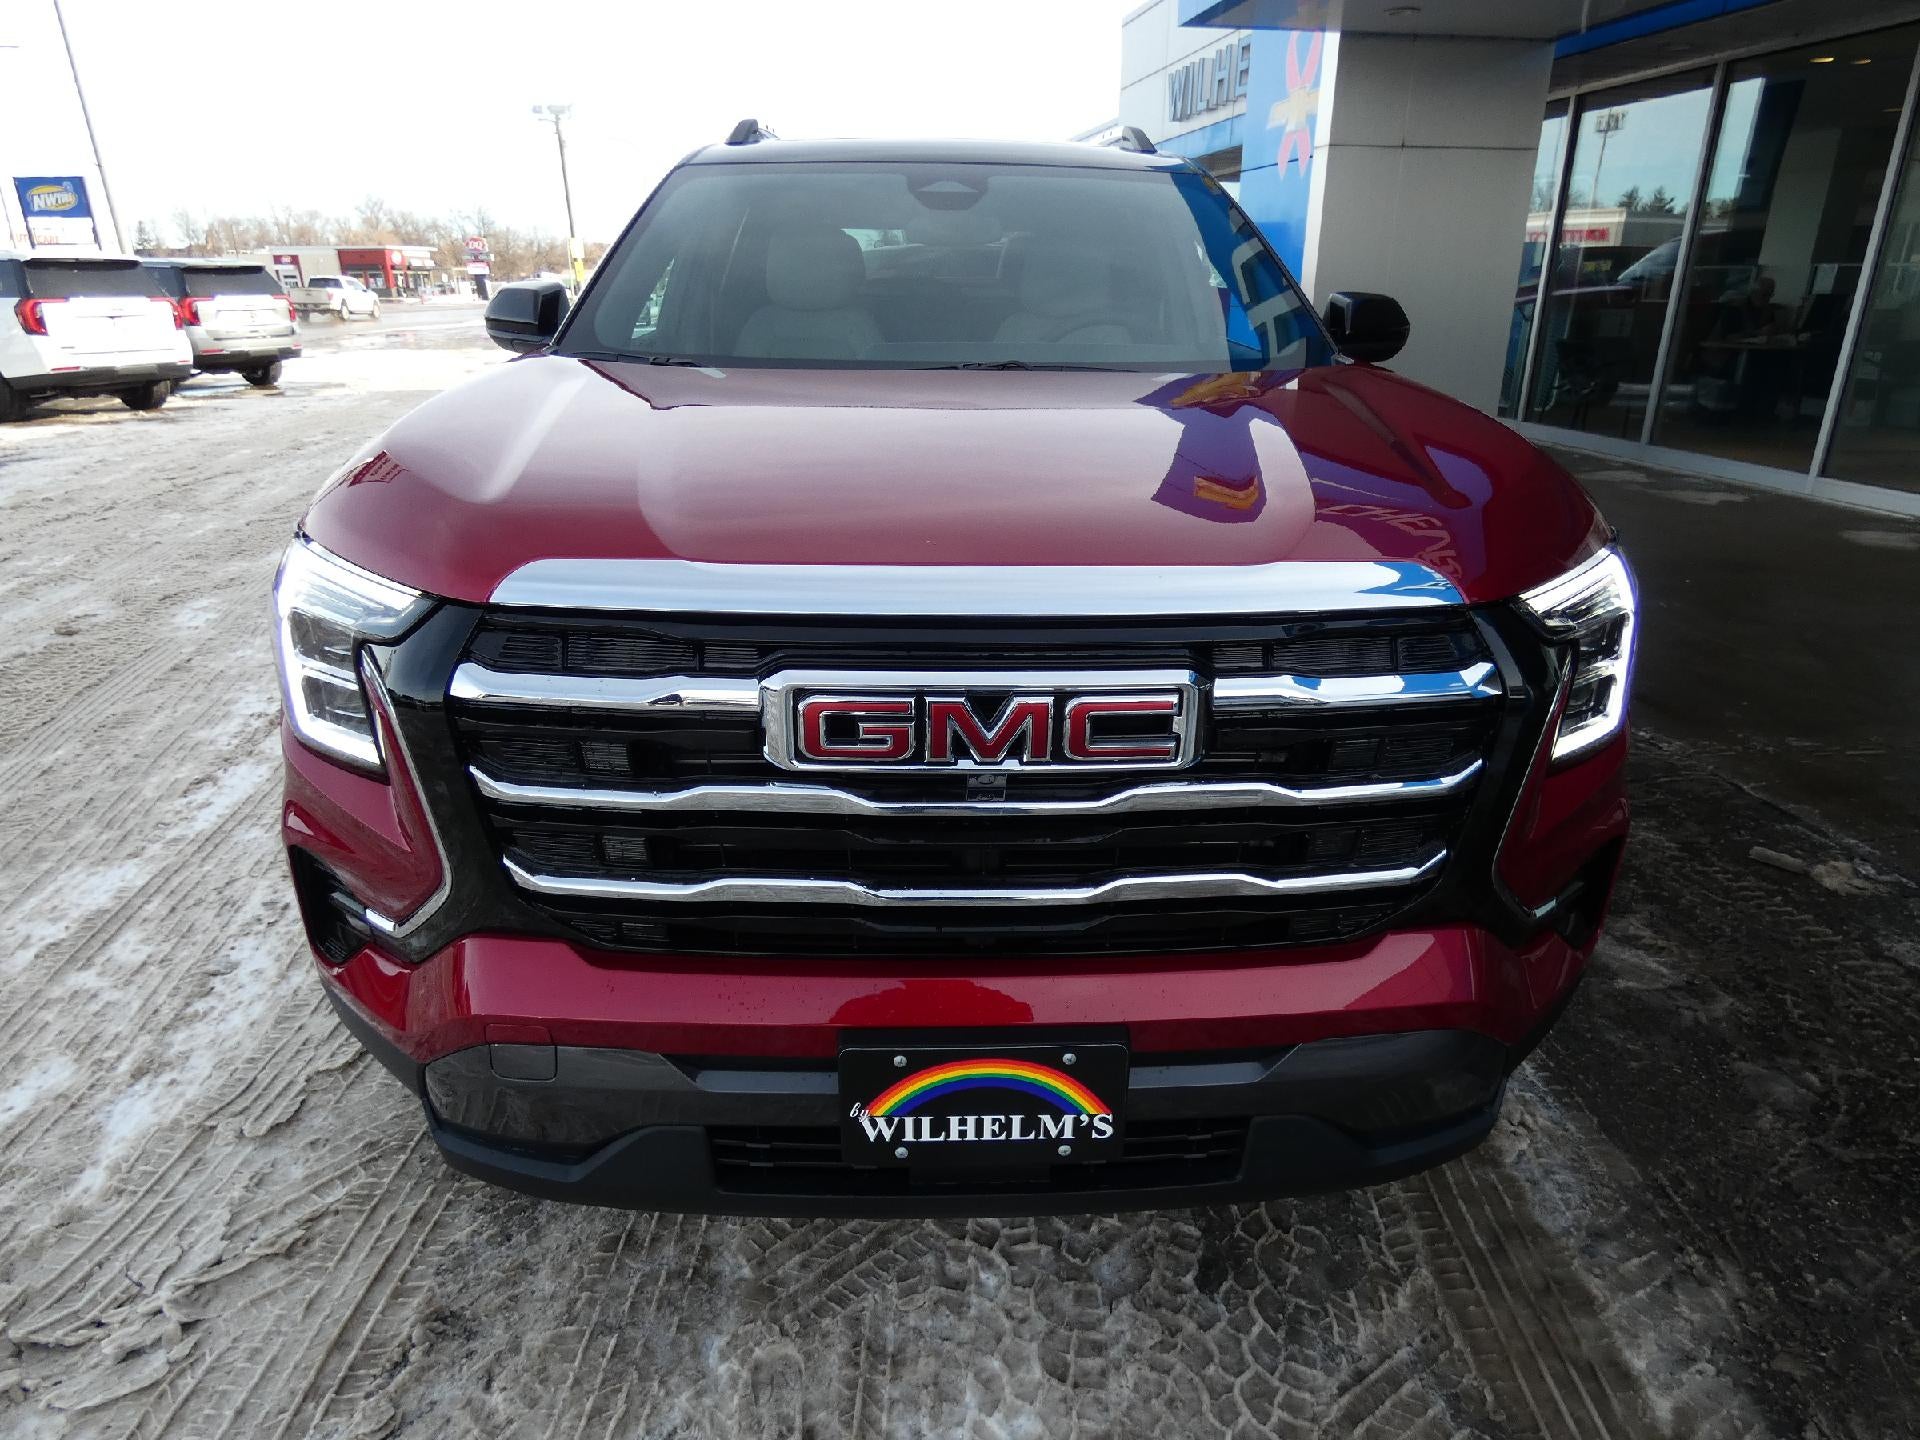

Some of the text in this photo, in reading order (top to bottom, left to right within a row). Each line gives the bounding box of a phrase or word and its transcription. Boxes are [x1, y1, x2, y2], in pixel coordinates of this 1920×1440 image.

[798, 694, 1180, 763] GMC
[849, 1102, 872, 1123] by
[861, 1112, 1115, 1143] WILHELM'S
